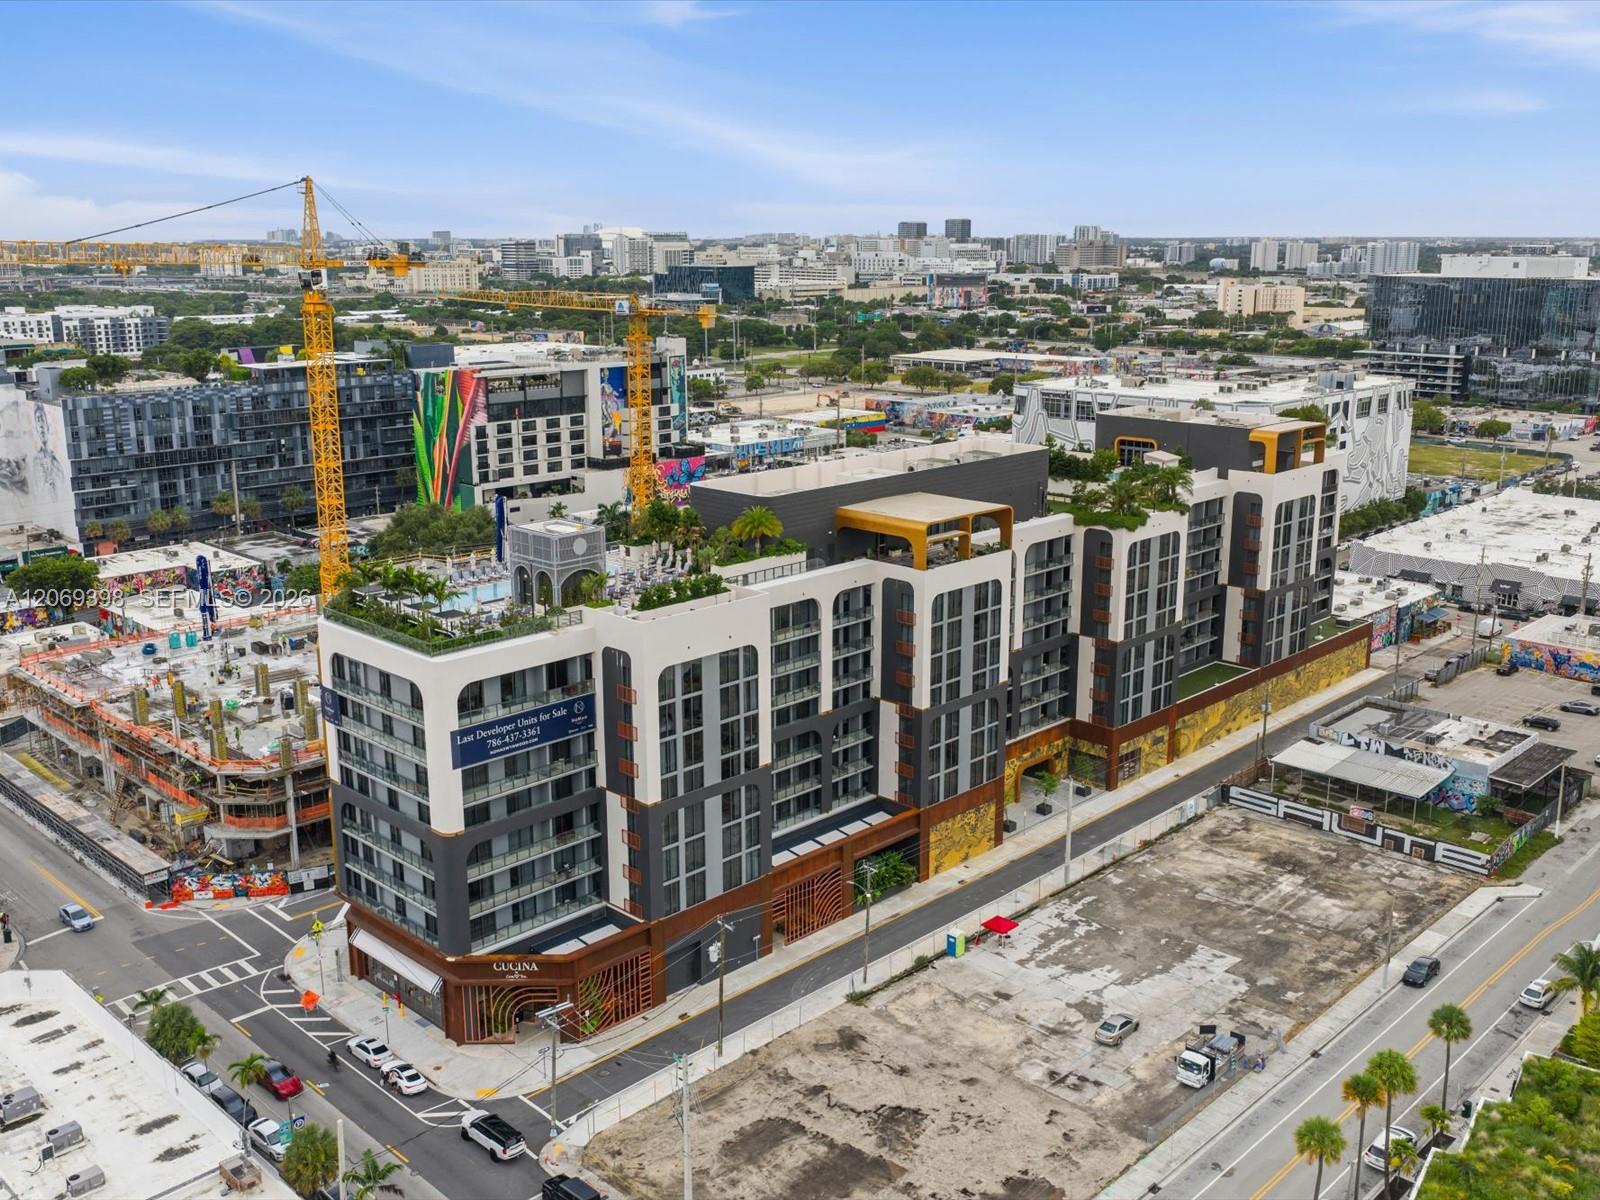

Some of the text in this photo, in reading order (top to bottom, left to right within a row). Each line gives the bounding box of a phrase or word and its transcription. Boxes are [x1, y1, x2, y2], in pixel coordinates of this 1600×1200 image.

[457, 707, 568, 745] Last Developer Units for Sale
[486, 726, 541, 749] 786-437-3361
[493, 962, 539, 971] CUCINA
